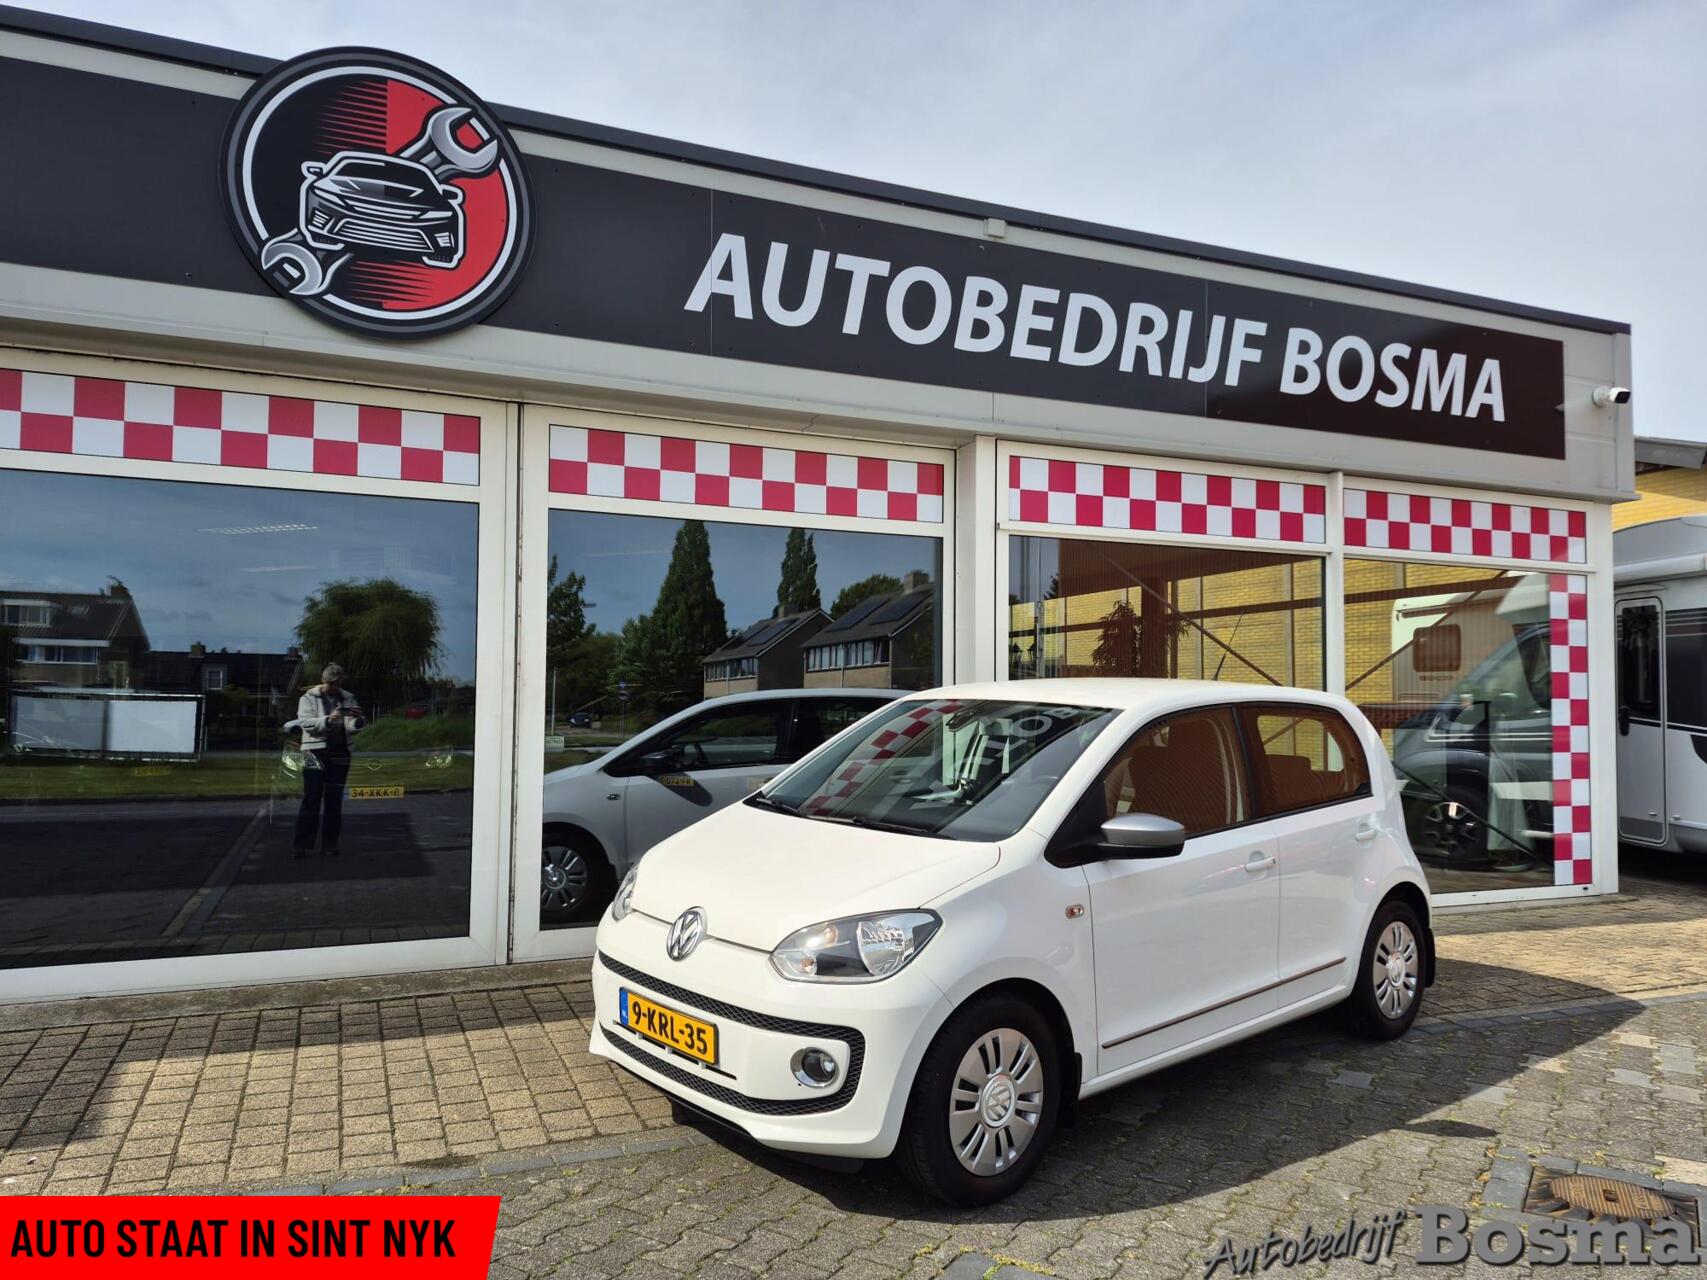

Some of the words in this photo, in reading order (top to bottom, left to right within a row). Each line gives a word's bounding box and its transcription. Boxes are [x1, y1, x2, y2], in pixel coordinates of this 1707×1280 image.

[684, 232, 1267, 387] AUTOBEDRIJF
[1280, 327, 1505, 422] BOSMA
[632, 1001, 707, 1055] 9-KRL-35
